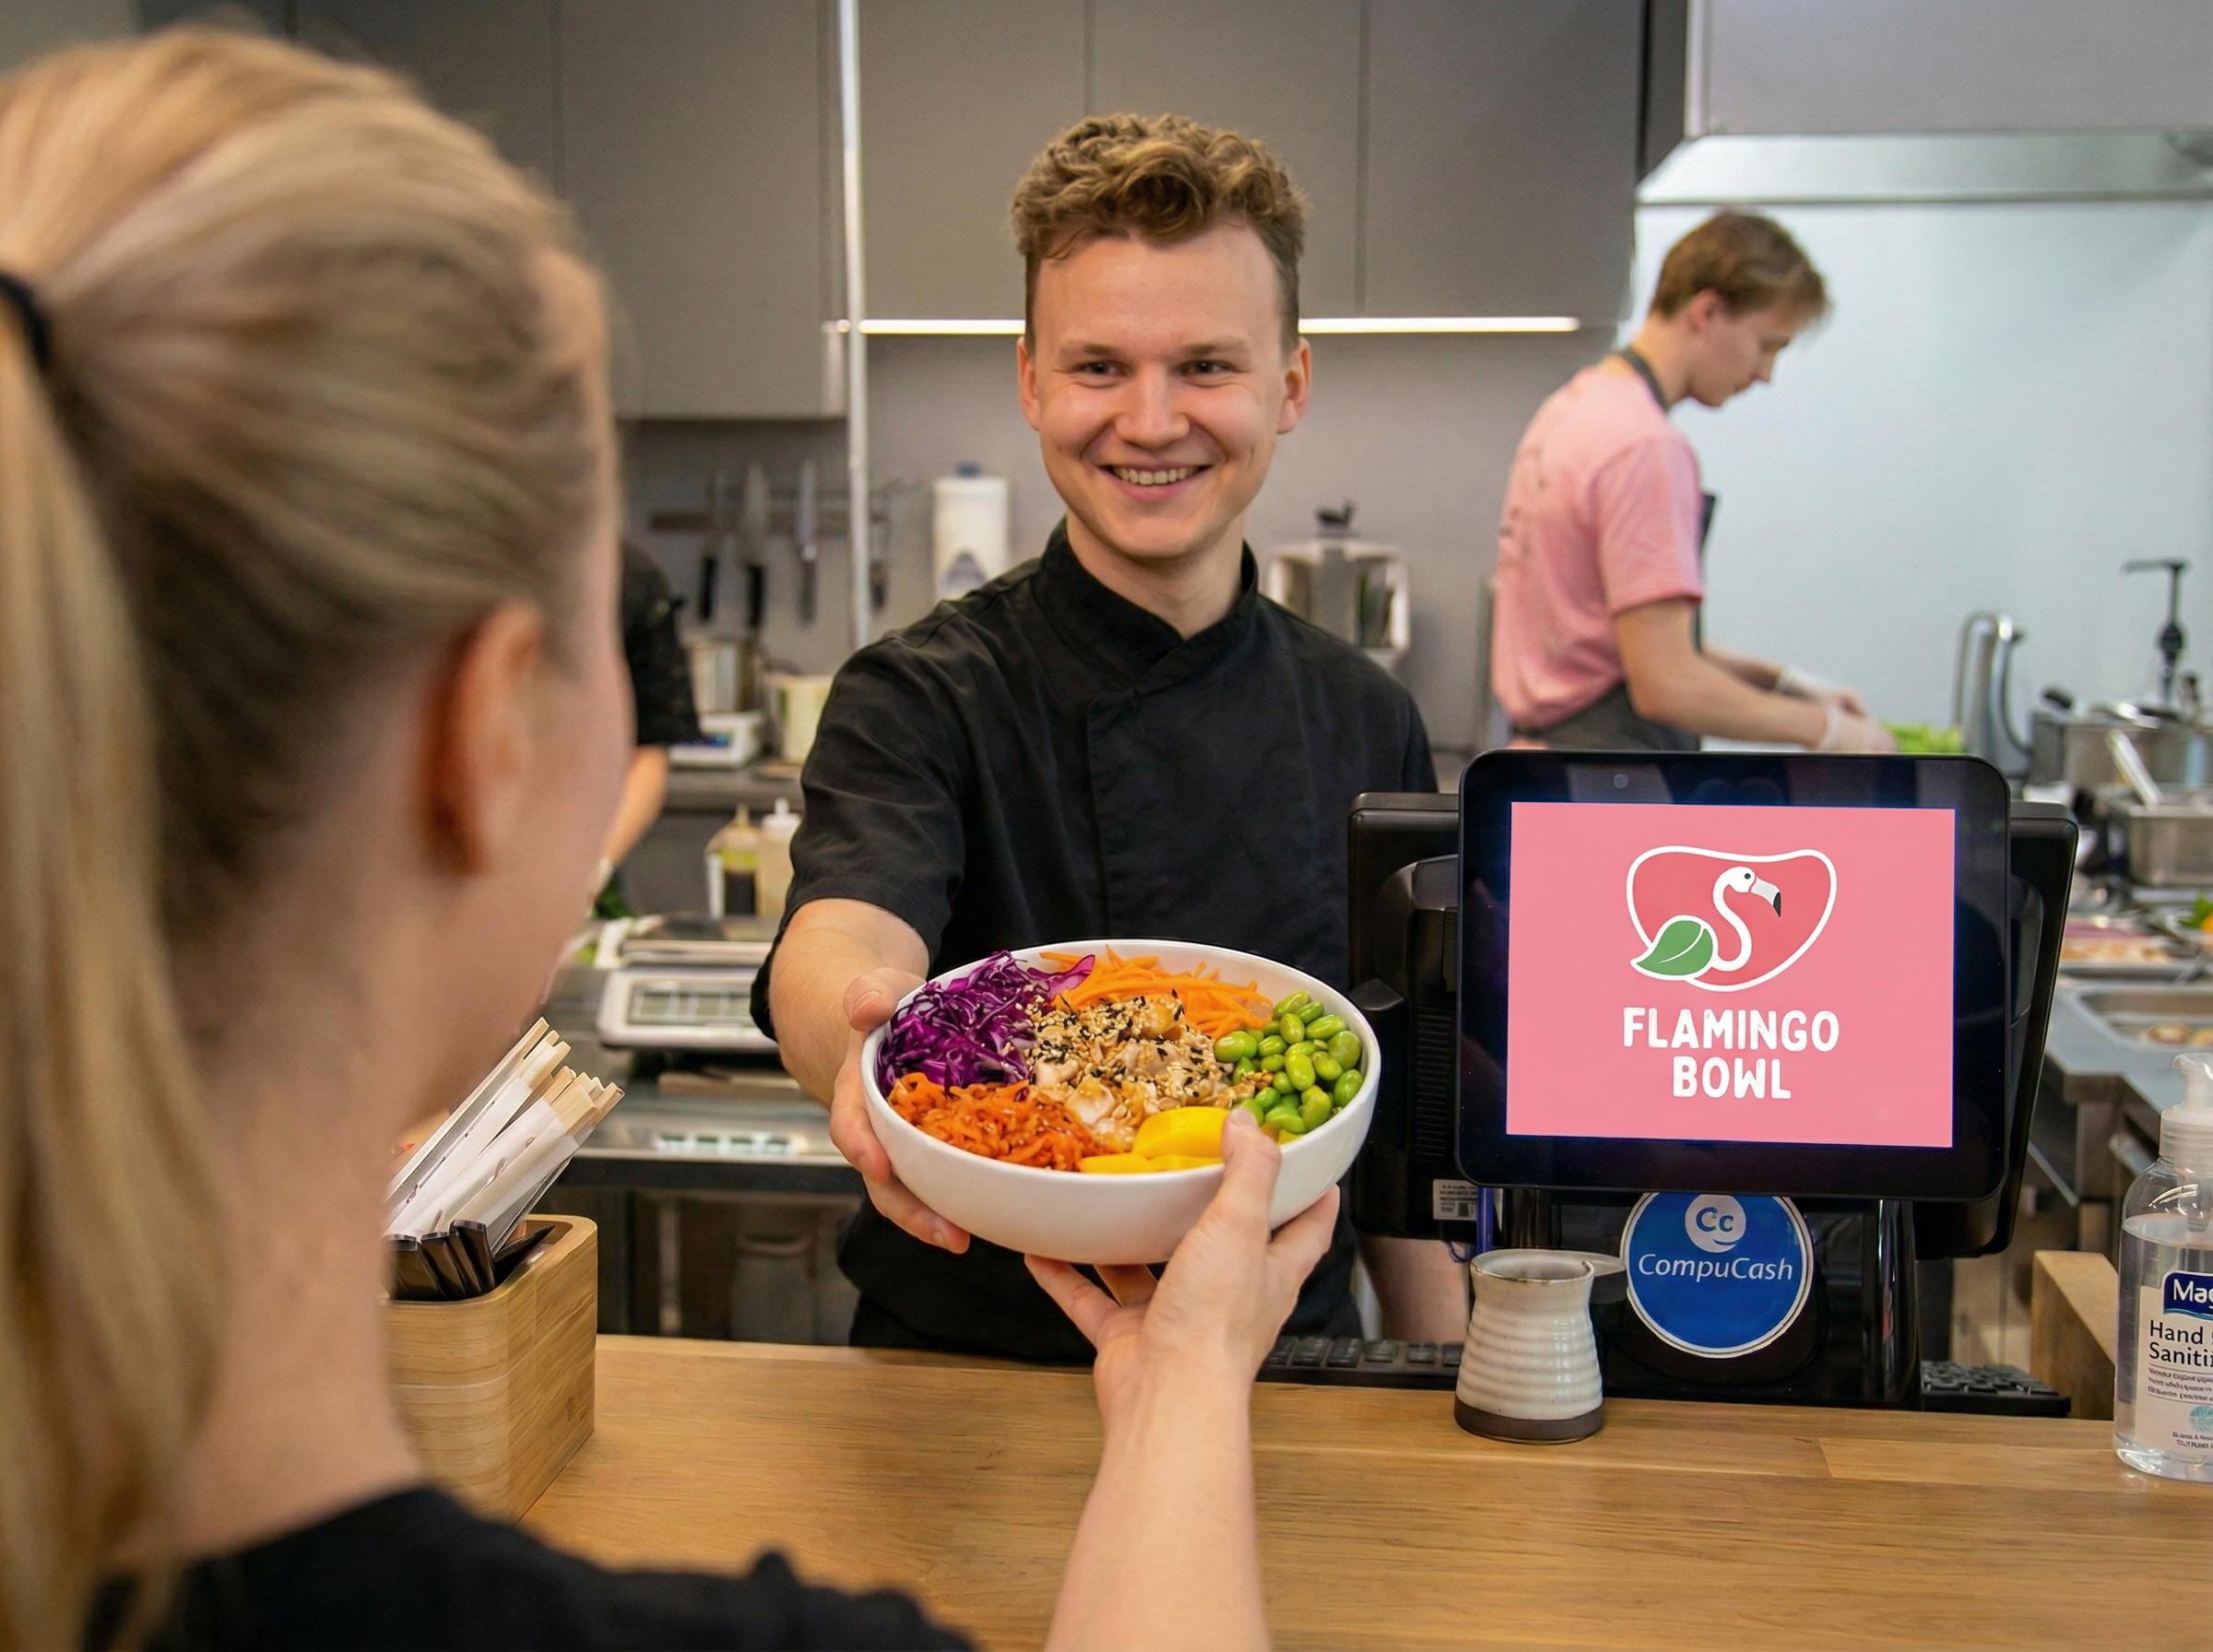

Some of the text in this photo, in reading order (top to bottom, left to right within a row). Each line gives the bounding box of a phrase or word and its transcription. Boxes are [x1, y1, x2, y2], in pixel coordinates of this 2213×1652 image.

[1623, 1007, 1840, 1052] FLAMINGO
[1673, 1056, 1792, 1099] BOWL
[1638, 1254, 1793, 1282] CompuCash
[2149, 1319, 2204, 1345] Hand
[2148, 1341, 2213, 1368] Saniti
